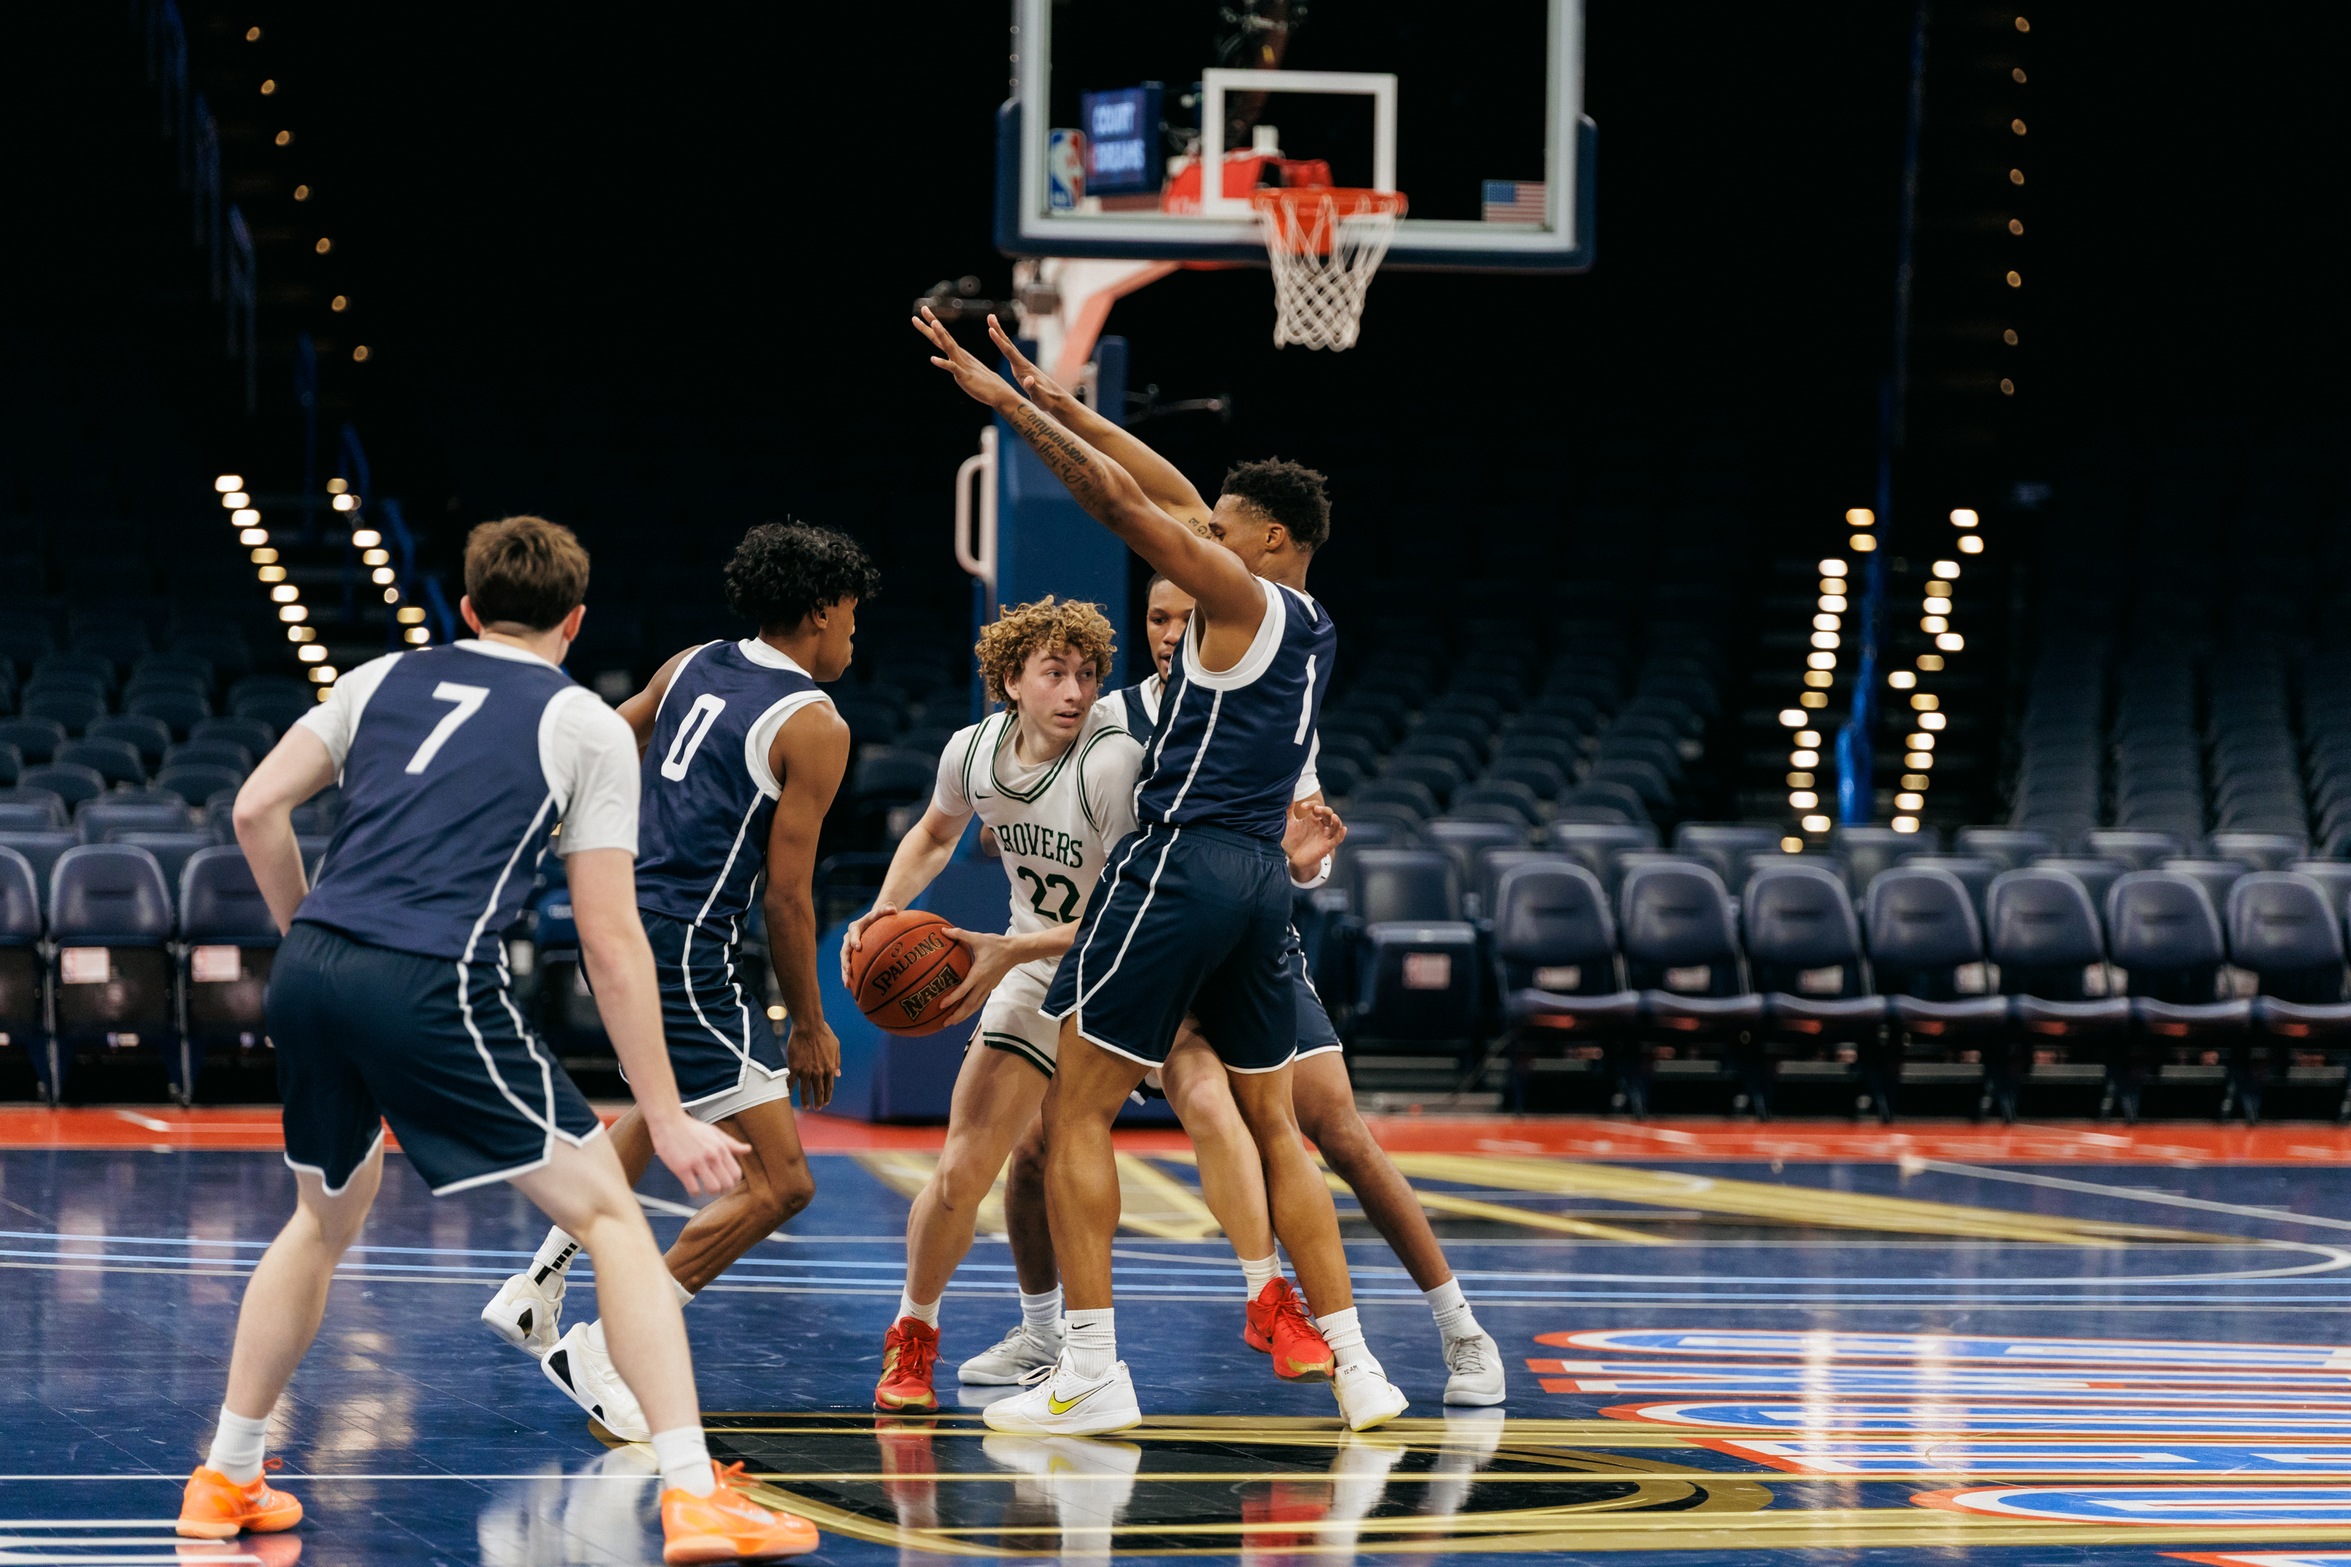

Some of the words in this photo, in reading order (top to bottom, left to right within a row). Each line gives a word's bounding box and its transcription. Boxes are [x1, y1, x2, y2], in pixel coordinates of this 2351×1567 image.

[1017, 403, 1088, 466] Comparison
[404, 681, 491, 775] 7
[1293, 654, 1317, 746] 1
[660, 693, 726, 782] 0
[990, 822, 1084, 868] ROVERS
[1016, 865, 1082, 924] 22
[871, 931, 946, 997] SPALDING
[901, 966, 961, 1020] NAIA
